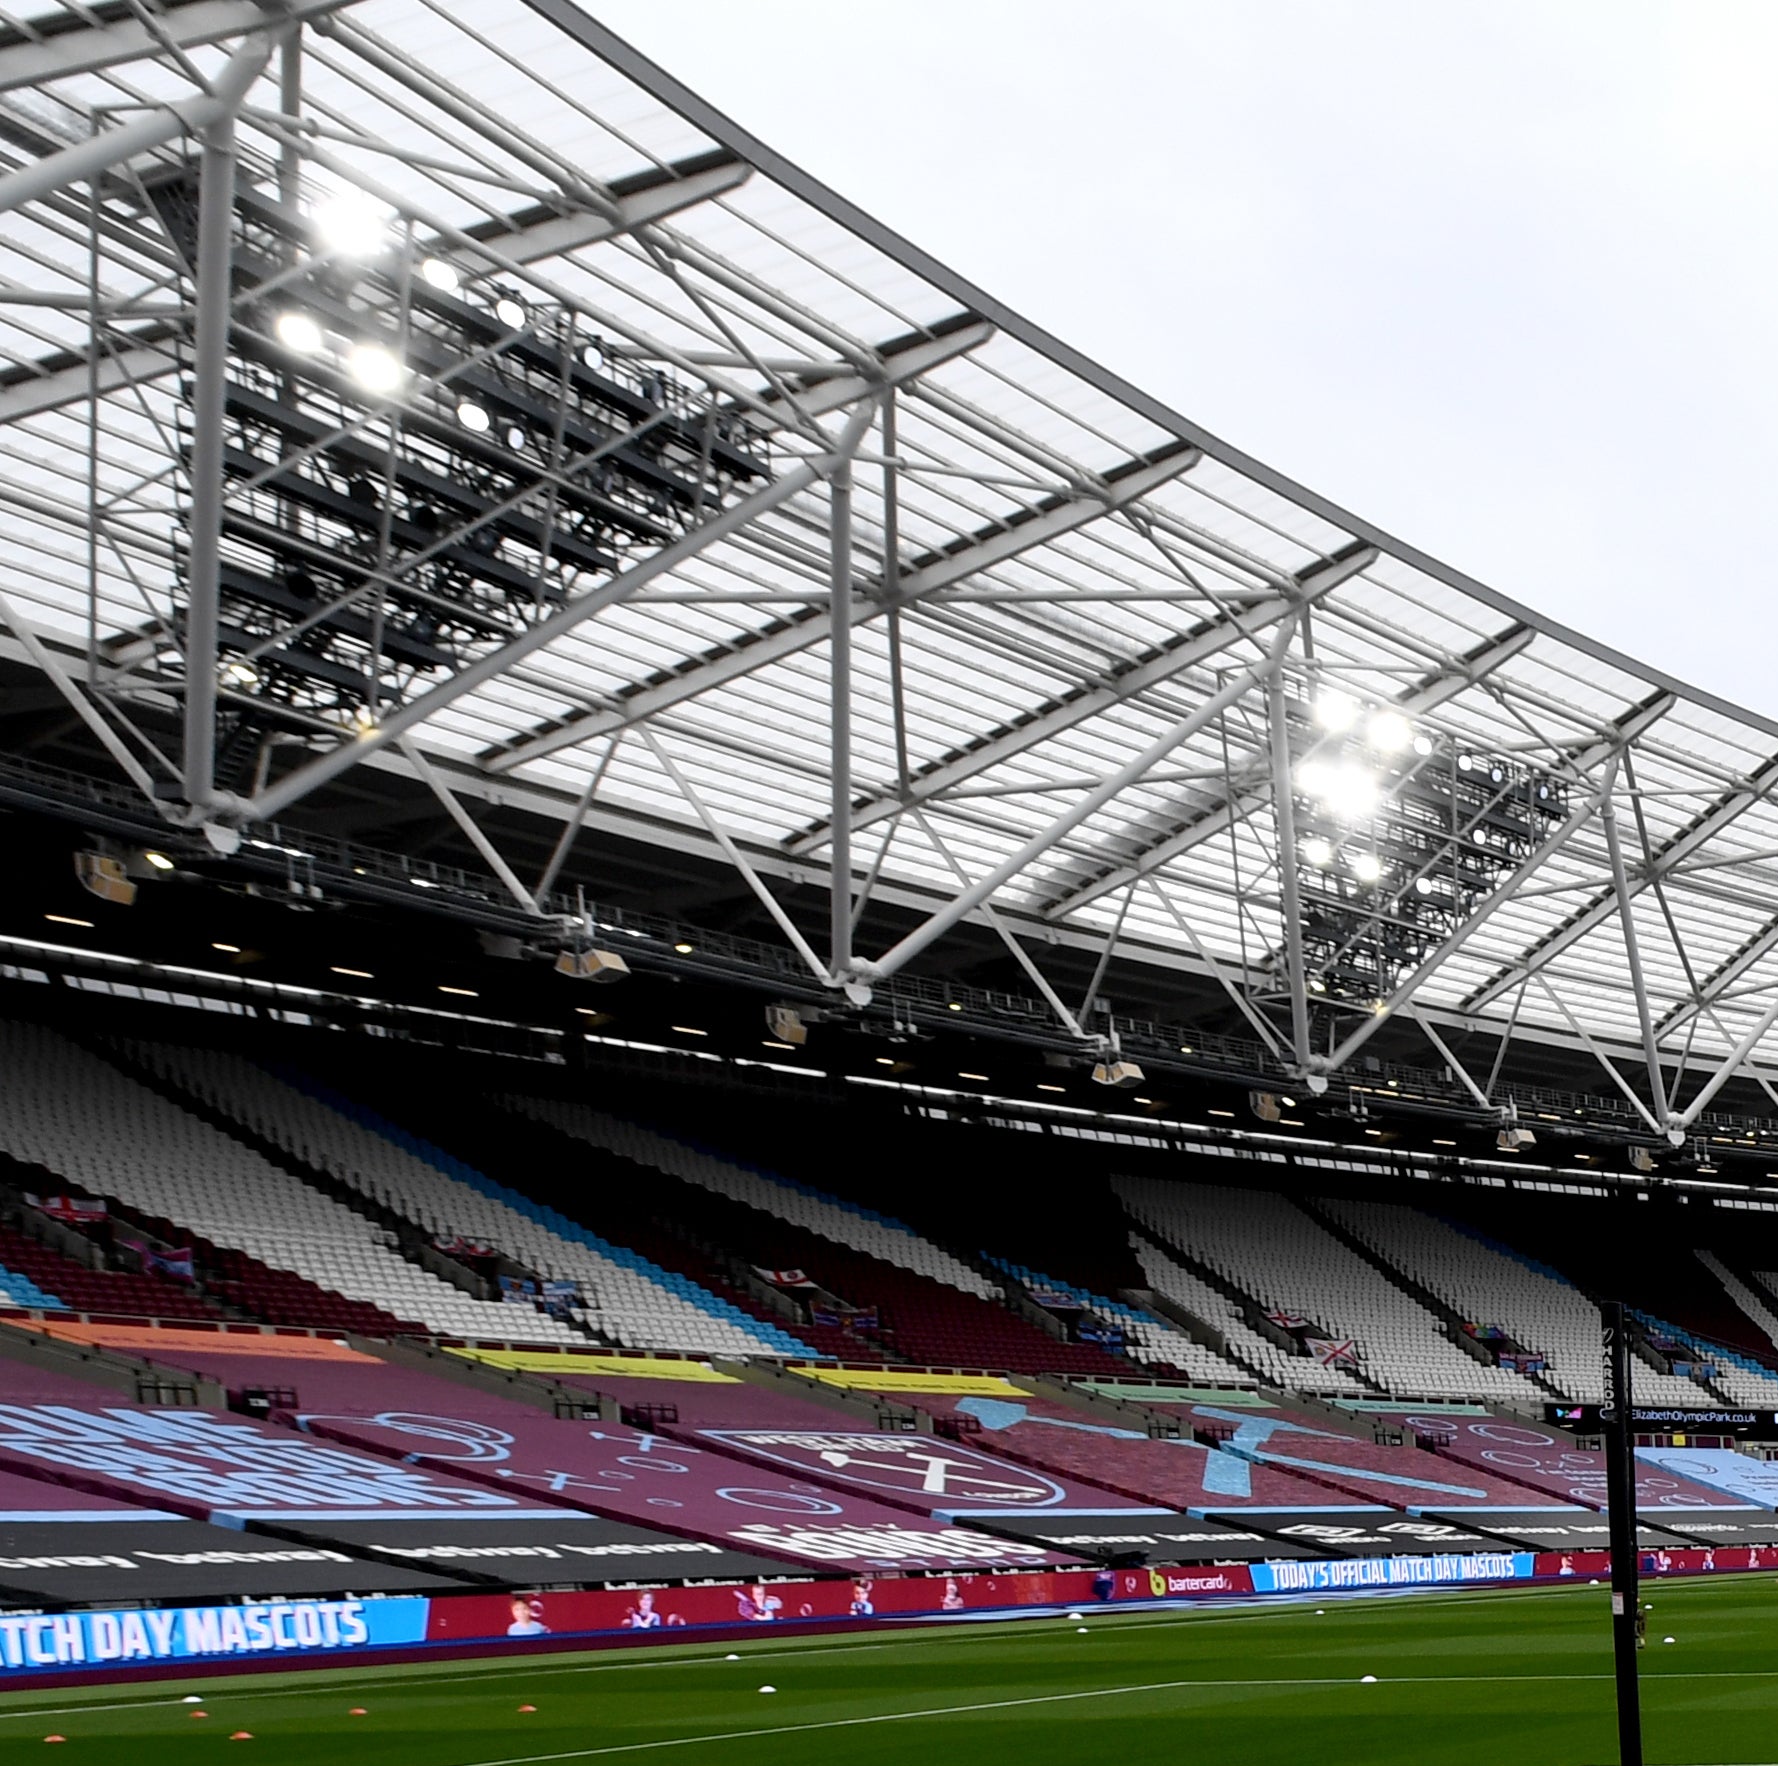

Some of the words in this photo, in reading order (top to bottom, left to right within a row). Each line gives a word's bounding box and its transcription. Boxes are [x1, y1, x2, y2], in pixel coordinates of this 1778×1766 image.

[1602, 1344, 1616, 1412] HARROD
[726, 1529, 1048, 1559] BOUNDS
[1168, 1575, 1224, 1592] bartercard
[1271, 1563, 1328, 1590] TODAY'S
[1330, 1561, 1387, 1587] OFFICIAL
[1390, 1559, 1432, 1584] MATCH
[1434, 1557, 1460, 1582] DAY
[1461, 1555, 1515, 1580] MASCOTS
[0, 1614, 86, 1668] TCH
[93, 1611, 175, 1662] DAY
[183, 1602, 371, 1656] MASCOTS
